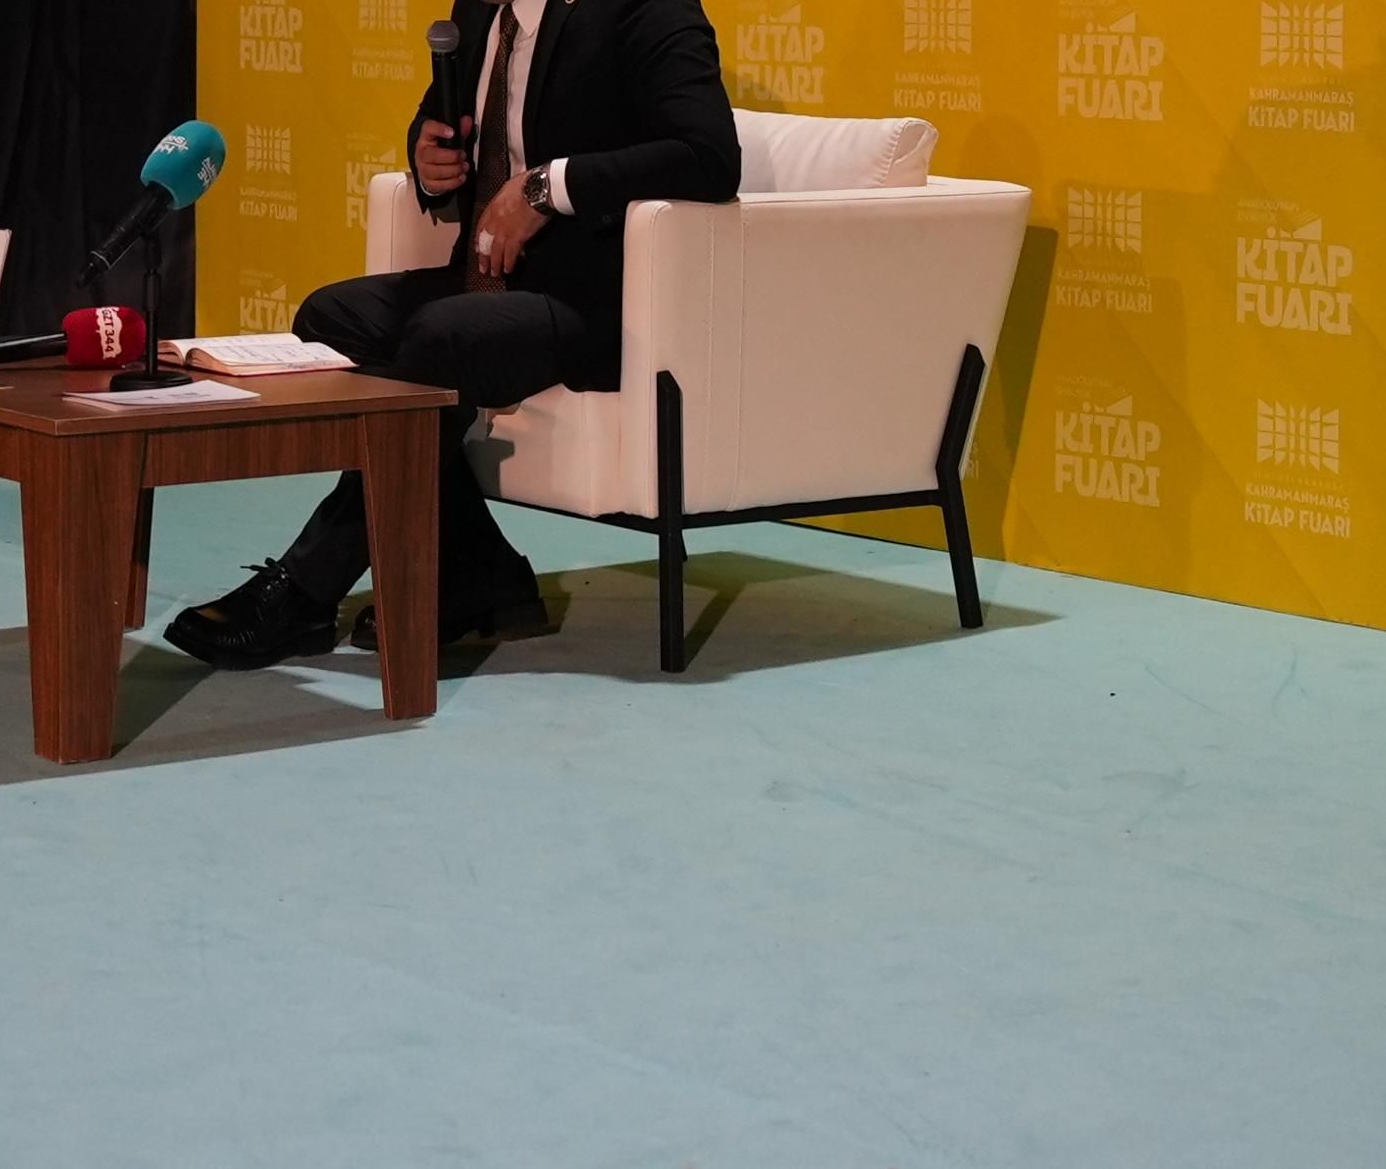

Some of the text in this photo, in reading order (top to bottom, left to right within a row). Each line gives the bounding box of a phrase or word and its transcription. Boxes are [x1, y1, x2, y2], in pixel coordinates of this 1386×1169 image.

[240, 38, 303, 73] FUARI
[736, 64, 824, 104] FUARI
[1057, 78, 1164, 122] FUARI
[1235, 280, 1354, 336] FUARI
[1055, 453, 1161, 508] FUARI
